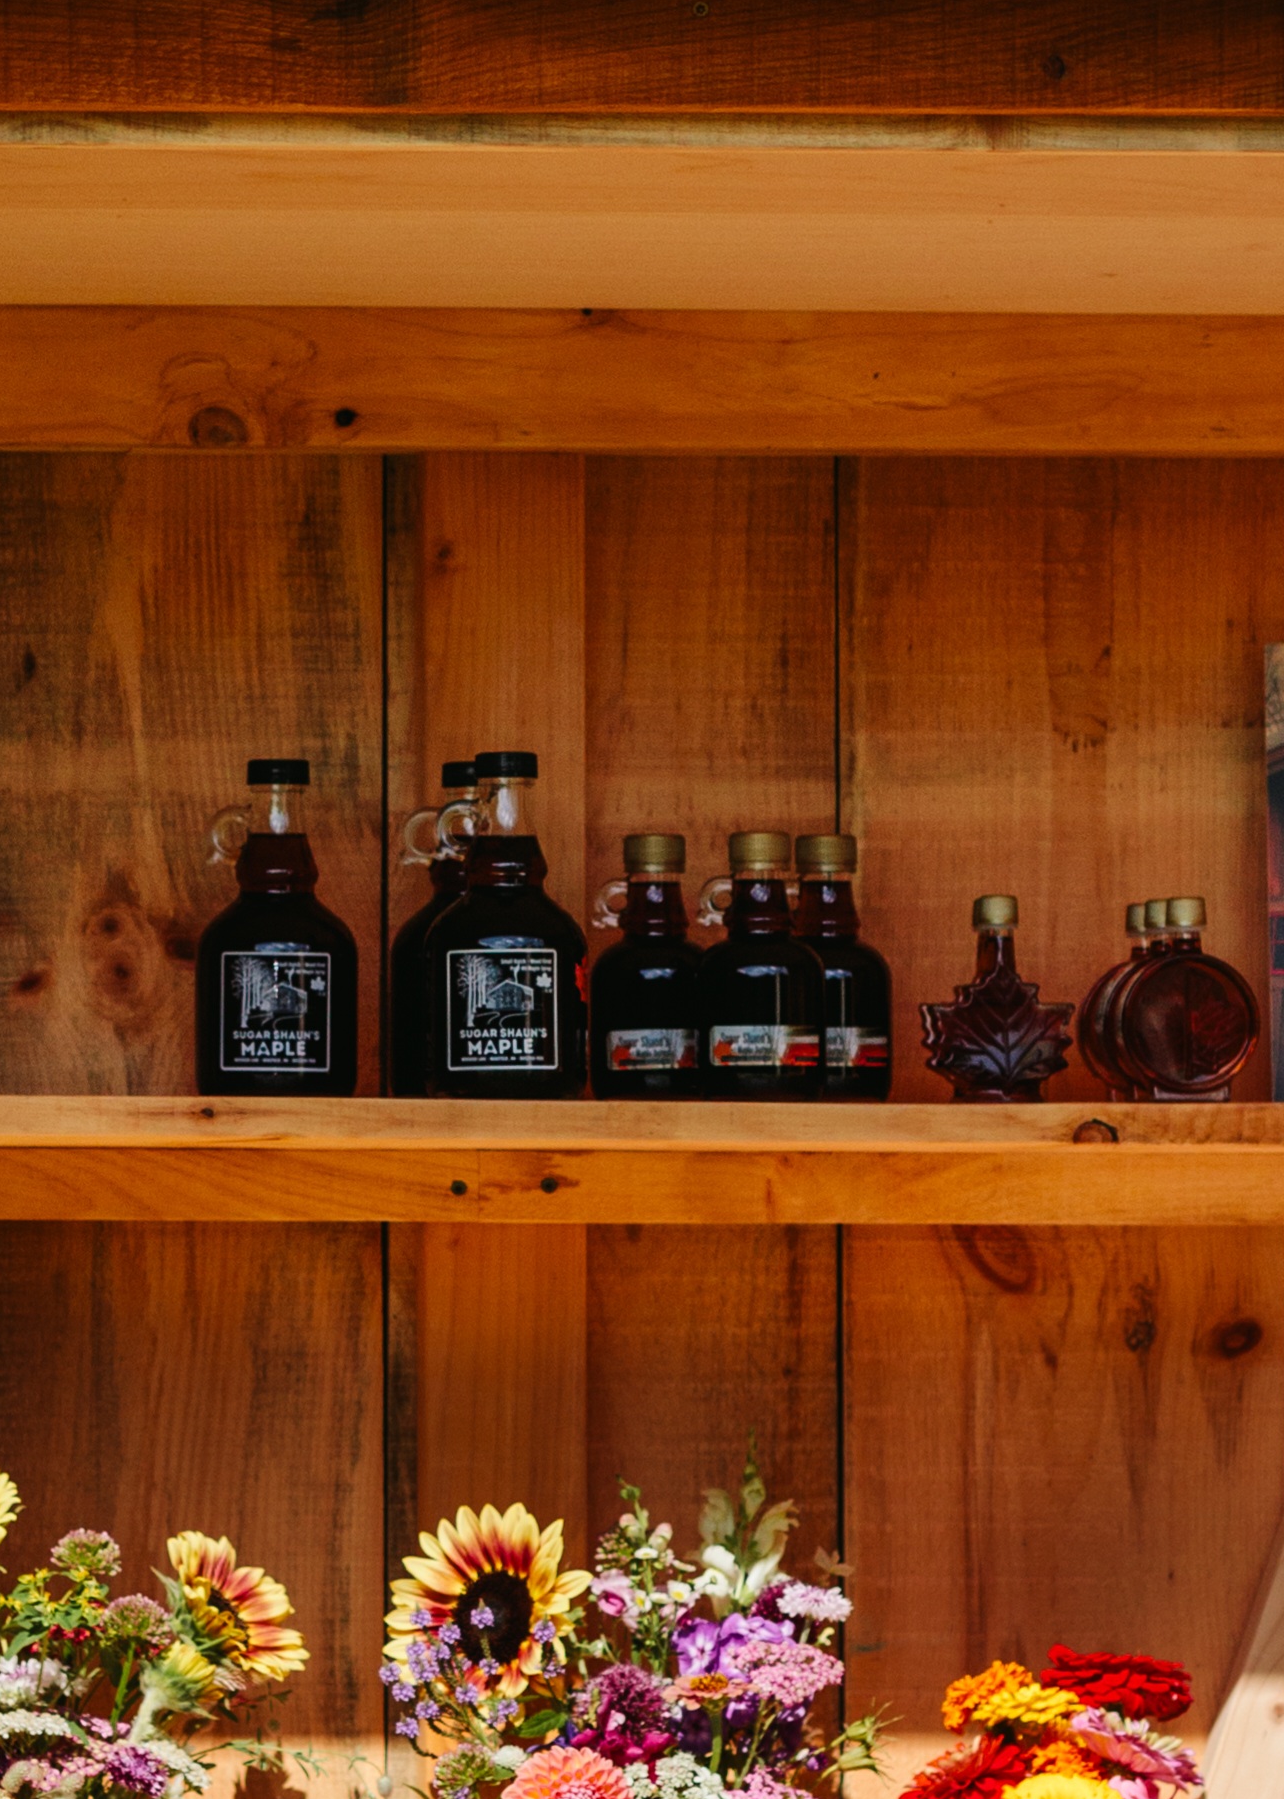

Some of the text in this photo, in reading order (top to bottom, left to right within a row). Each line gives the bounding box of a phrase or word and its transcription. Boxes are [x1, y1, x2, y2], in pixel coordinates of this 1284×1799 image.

[233, 1030, 320, 1041] SUGAR SHAUN'S
[460, 1028, 547, 1039] SUGAR SHAUN'S
[241, 1041, 306, 1056] MAPLE
[468, 1039, 534, 1055] MAPLE
